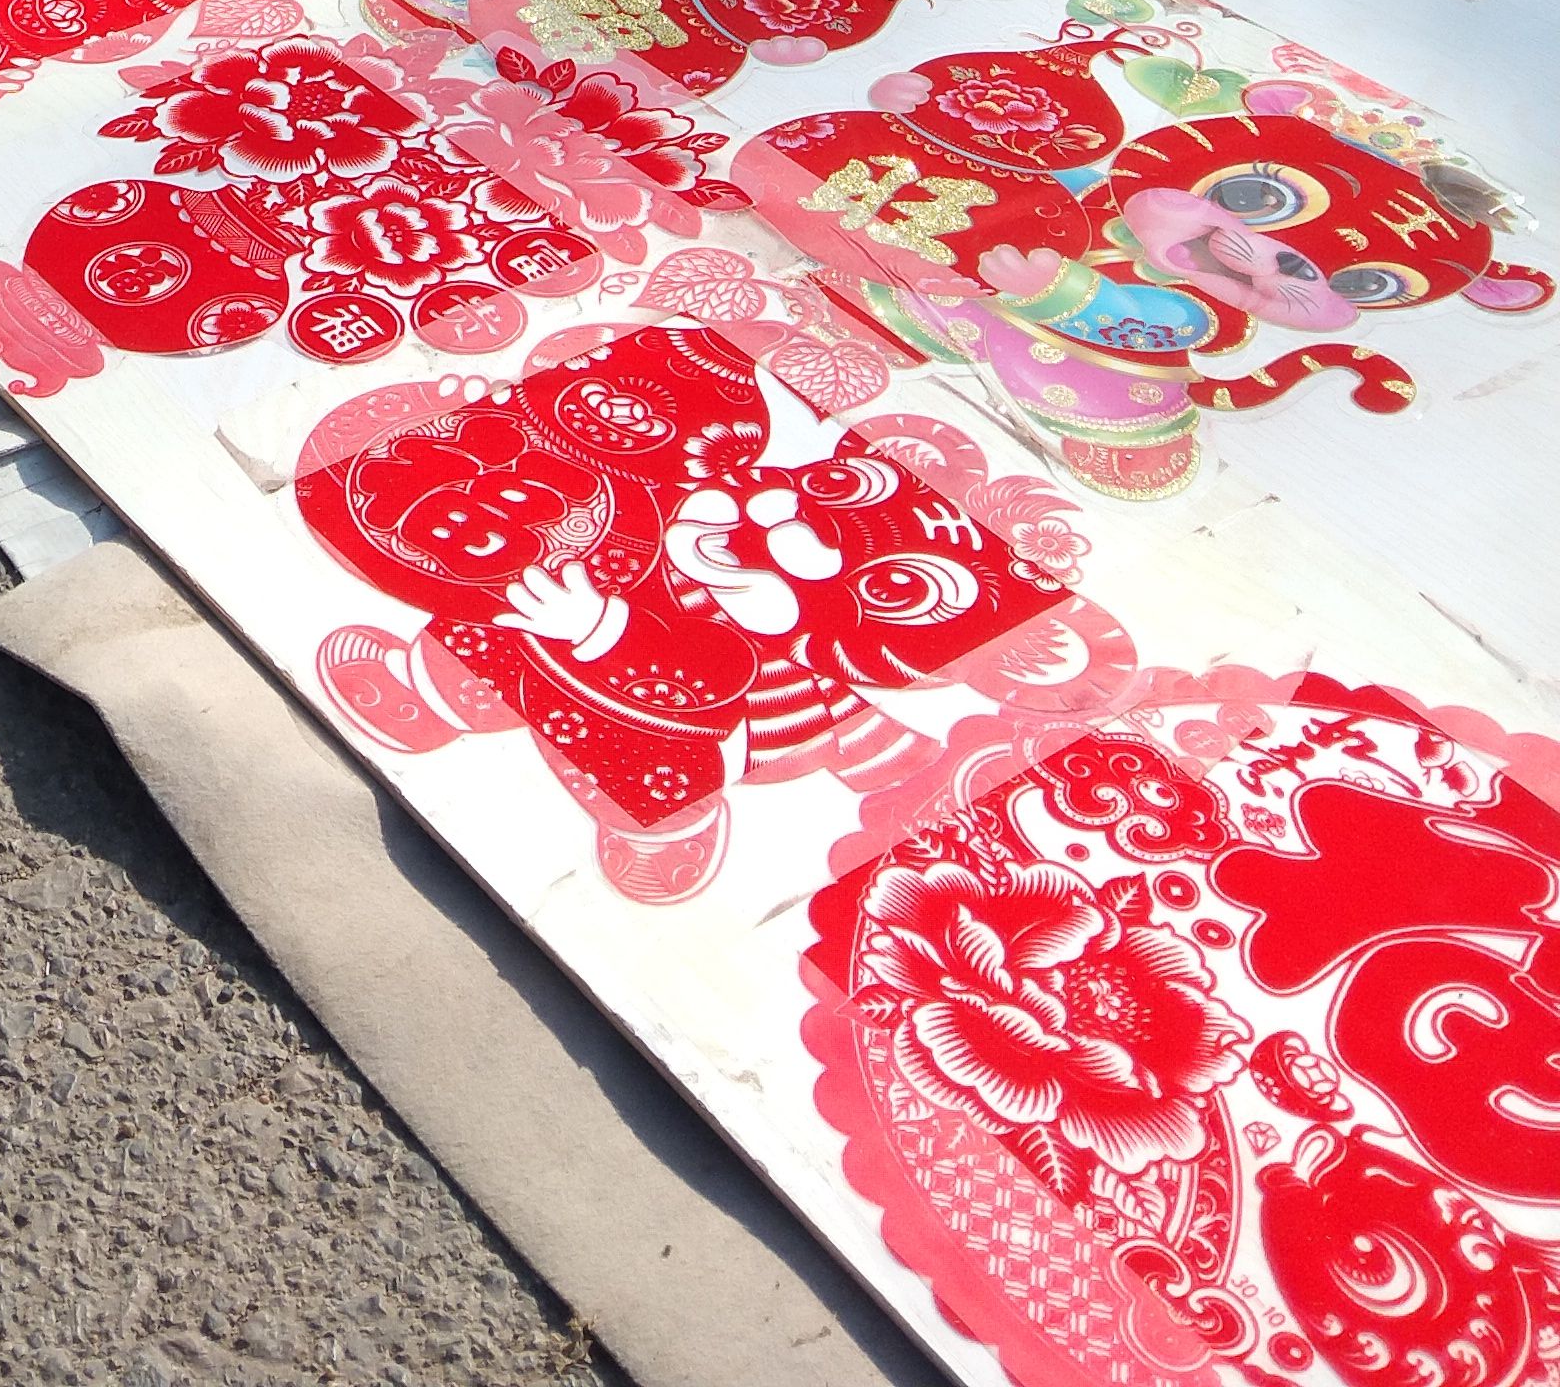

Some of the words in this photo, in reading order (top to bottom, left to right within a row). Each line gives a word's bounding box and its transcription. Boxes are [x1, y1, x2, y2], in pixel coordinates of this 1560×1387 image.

[351, 414, 602, 581] 福
[915, 501, 983, 553] 王
[1230, 1273, 1287, 1330] 30-10
